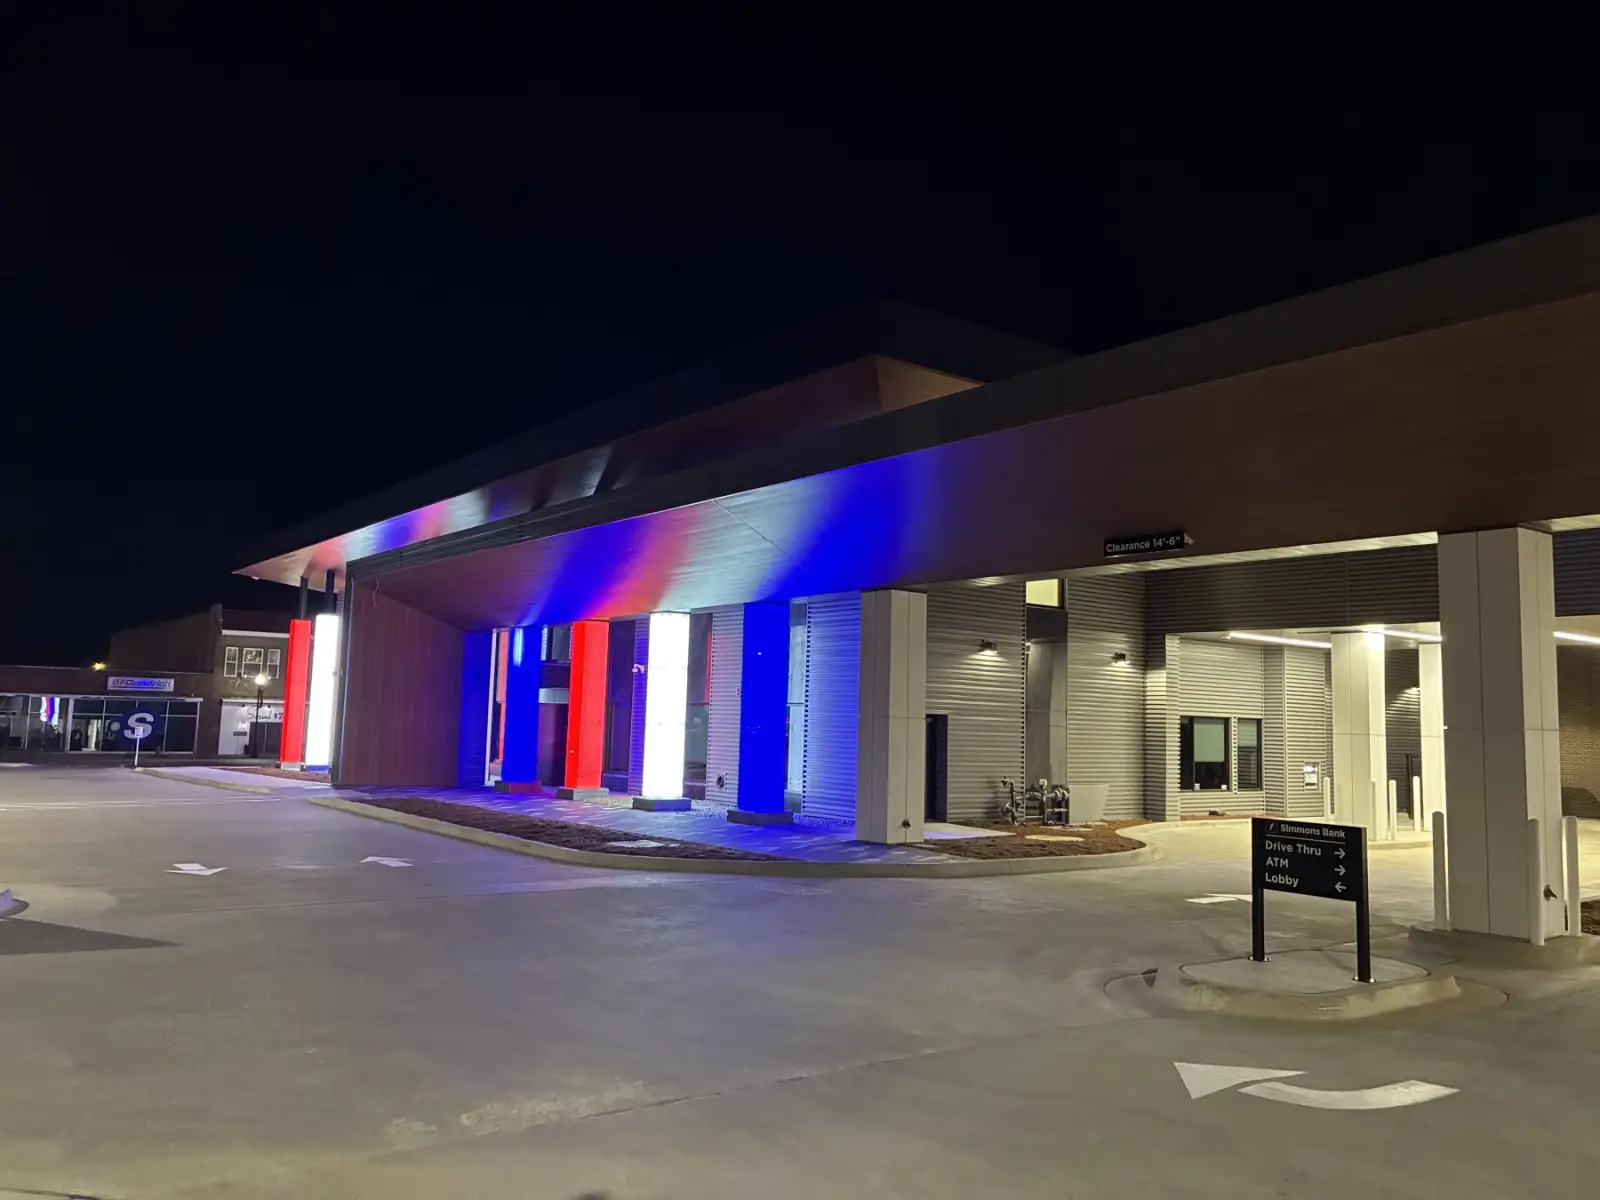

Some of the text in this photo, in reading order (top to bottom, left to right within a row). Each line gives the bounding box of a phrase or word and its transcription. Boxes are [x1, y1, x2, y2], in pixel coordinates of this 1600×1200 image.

[1106, 541, 1150, 552] Clearance
[124, 712, 154, 739] S
[1280, 824, 1346, 838] Simmons Bank
[1265, 840, 1321, 856] Drive Thru
[1265, 856, 1289, 869] ATM
[1265, 872, 1299, 887] Lobby
